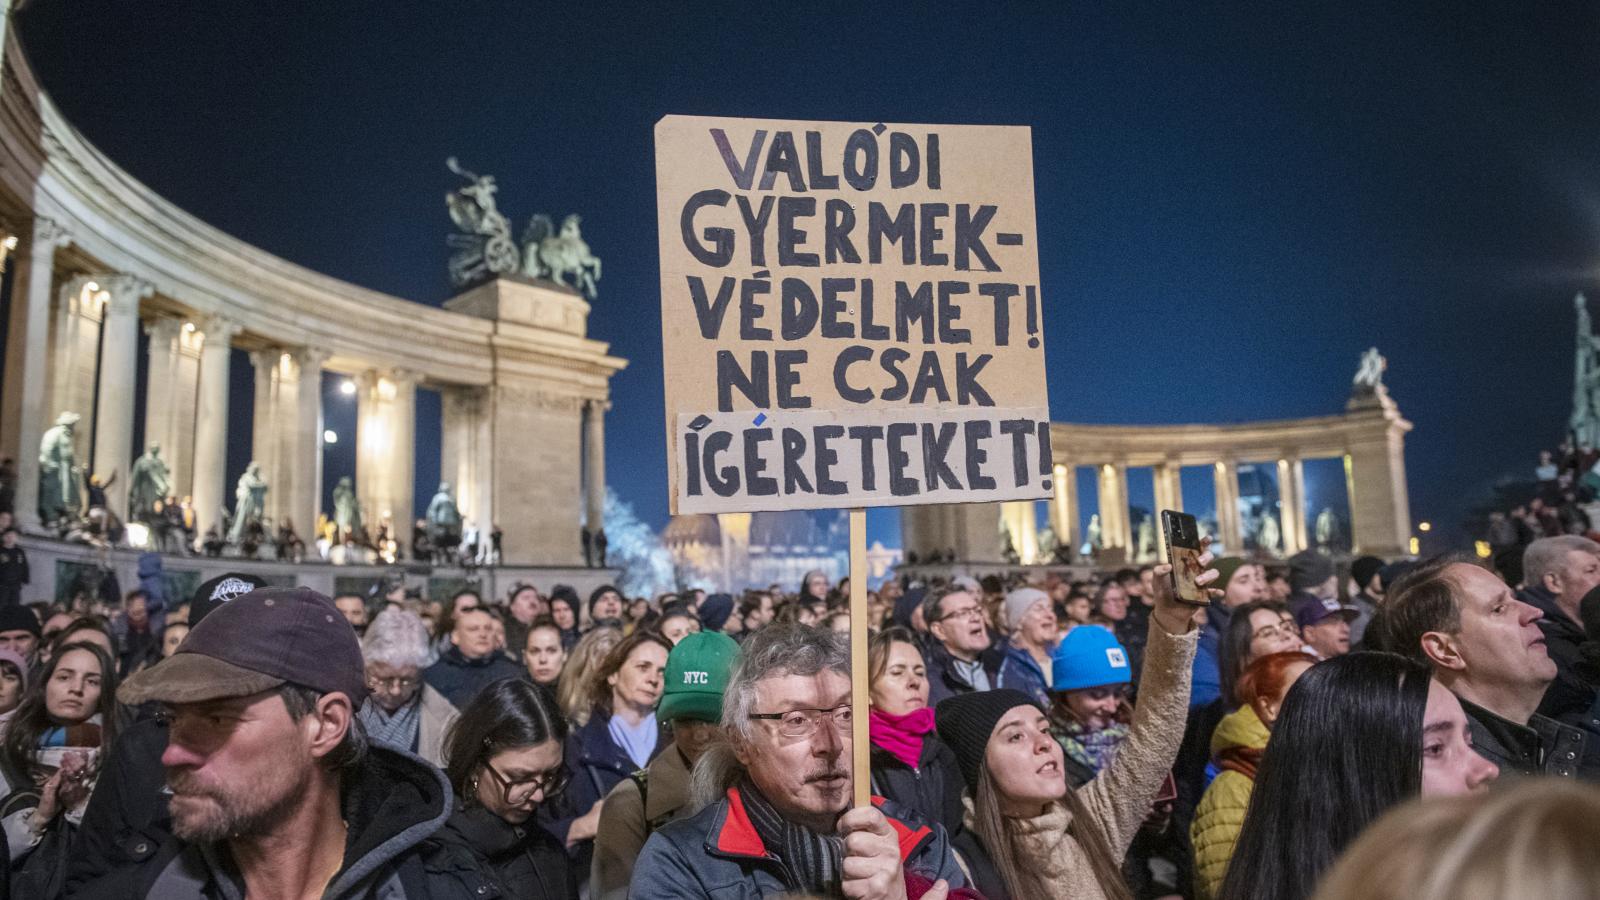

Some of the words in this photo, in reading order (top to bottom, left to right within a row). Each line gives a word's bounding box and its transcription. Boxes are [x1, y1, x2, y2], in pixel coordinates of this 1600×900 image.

[709, 122, 941, 192] VALÓDI
[680, 189, 1023, 272] GYERMEK-
[686, 270, 1040, 349] VÉDELMET!
[716, 349, 812, 412] NE
[833, 345, 996, 407] CSAK
[684, 412, 1053, 497] ÍGÉRETEKET!
[683, 671, 709, 684] NYC
